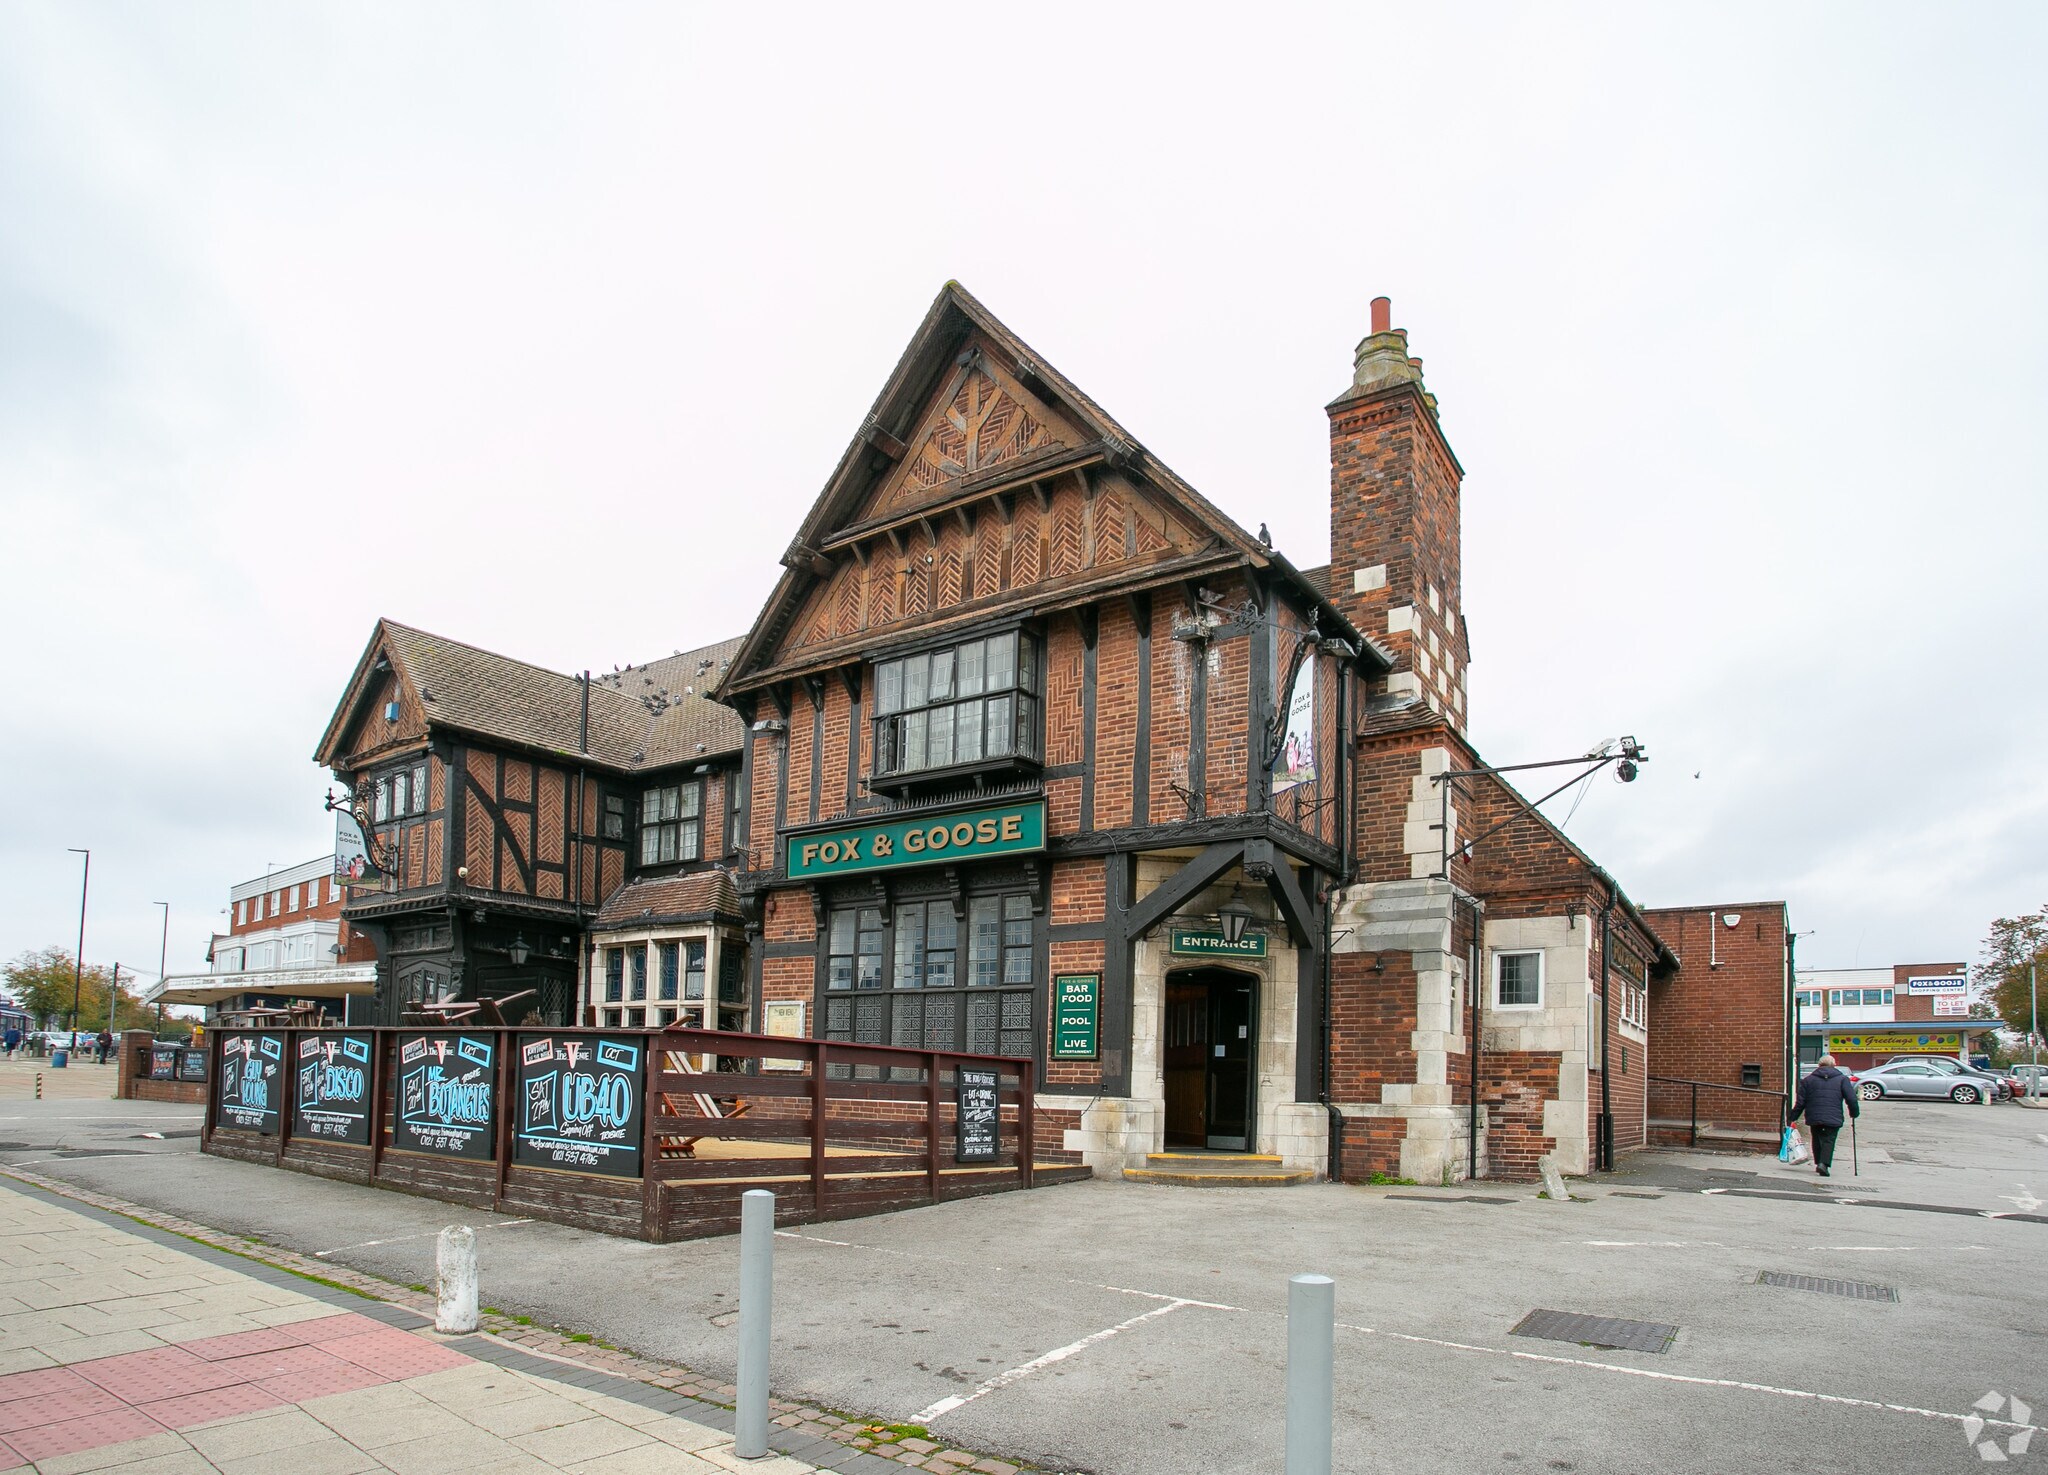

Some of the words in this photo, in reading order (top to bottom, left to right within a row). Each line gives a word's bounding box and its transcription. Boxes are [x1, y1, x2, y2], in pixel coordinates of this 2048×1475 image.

[1291, 701, 1310, 716] GOOSE
[339, 837, 361, 845] GOOSE
[802, 837, 861, 866] FOX
[872, 834, 892, 857] &
[903, 814, 1023, 853] GOOSE
[1182, 937, 1258, 949] ENTRANCE
[1062, 995, 1092, 1003] FOOD
[1865, 1036, 1913, 1045] Greetings
[348, 1043, 358, 1052] OCT
[464, 1044, 479, 1056] OCT
[555, 1050, 567, 1060] The
[605, 1048, 624, 1060] OCT
[324, 1065, 364, 1102] DISCO
[407, 1076, 420, 1095] SAT
[529, 1077, 553, 1100] SAT
[241, 1076, 267, 1109] YOUNG
[428, 1076, 490, 1124] BOJANGLES
[563, 1072, 632, 1128] UB40
[560, 1122, 582, 1137] Signing
[600, 1129, 626, 1140] TRIBUTE
[552, 1150, 563, 1160] 0121
